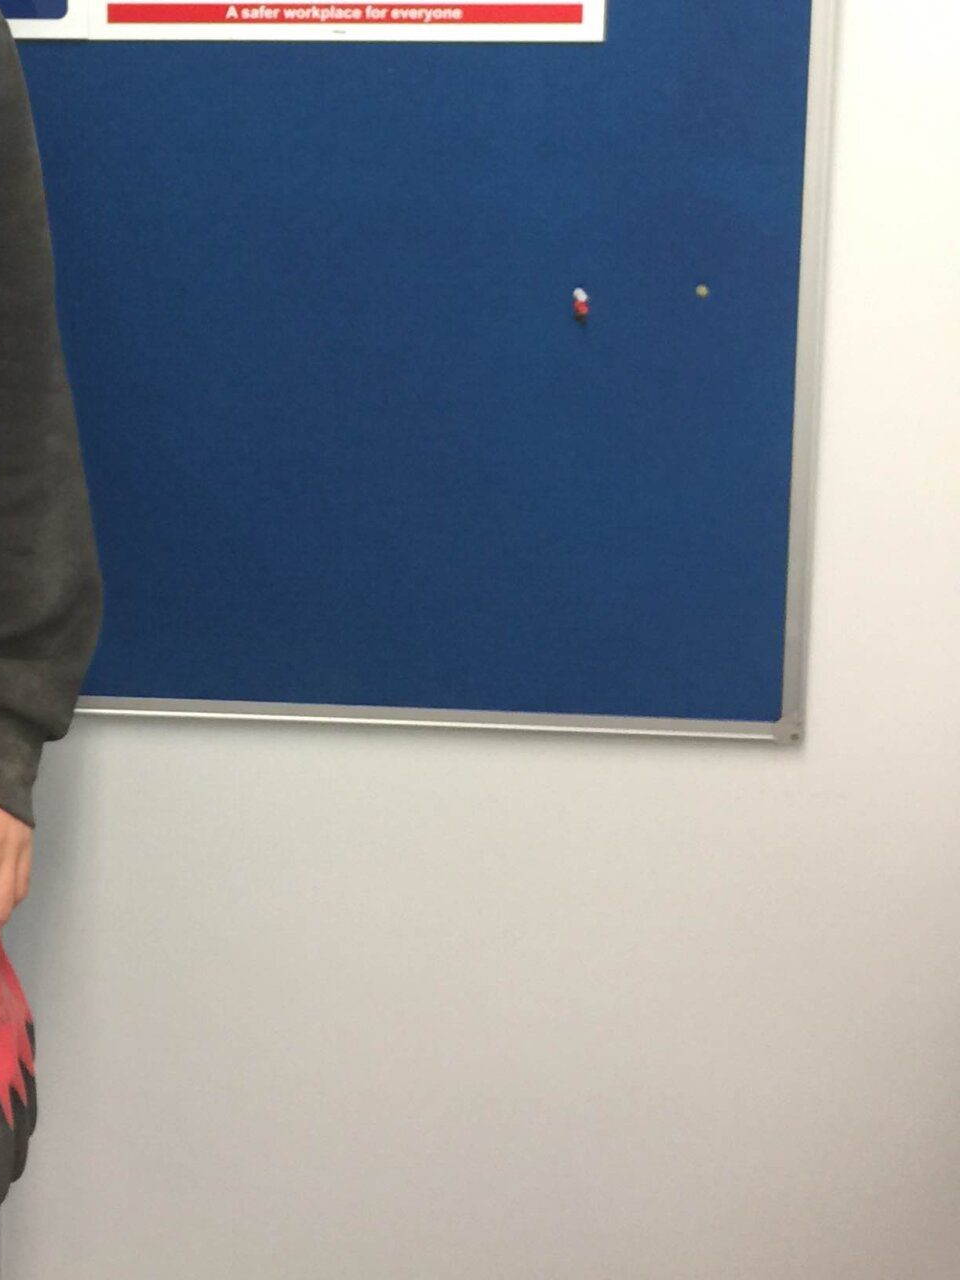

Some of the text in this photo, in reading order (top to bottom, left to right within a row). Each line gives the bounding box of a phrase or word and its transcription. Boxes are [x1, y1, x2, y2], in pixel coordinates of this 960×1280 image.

[226, 5, 464, 22] A safer workplace for everyone
